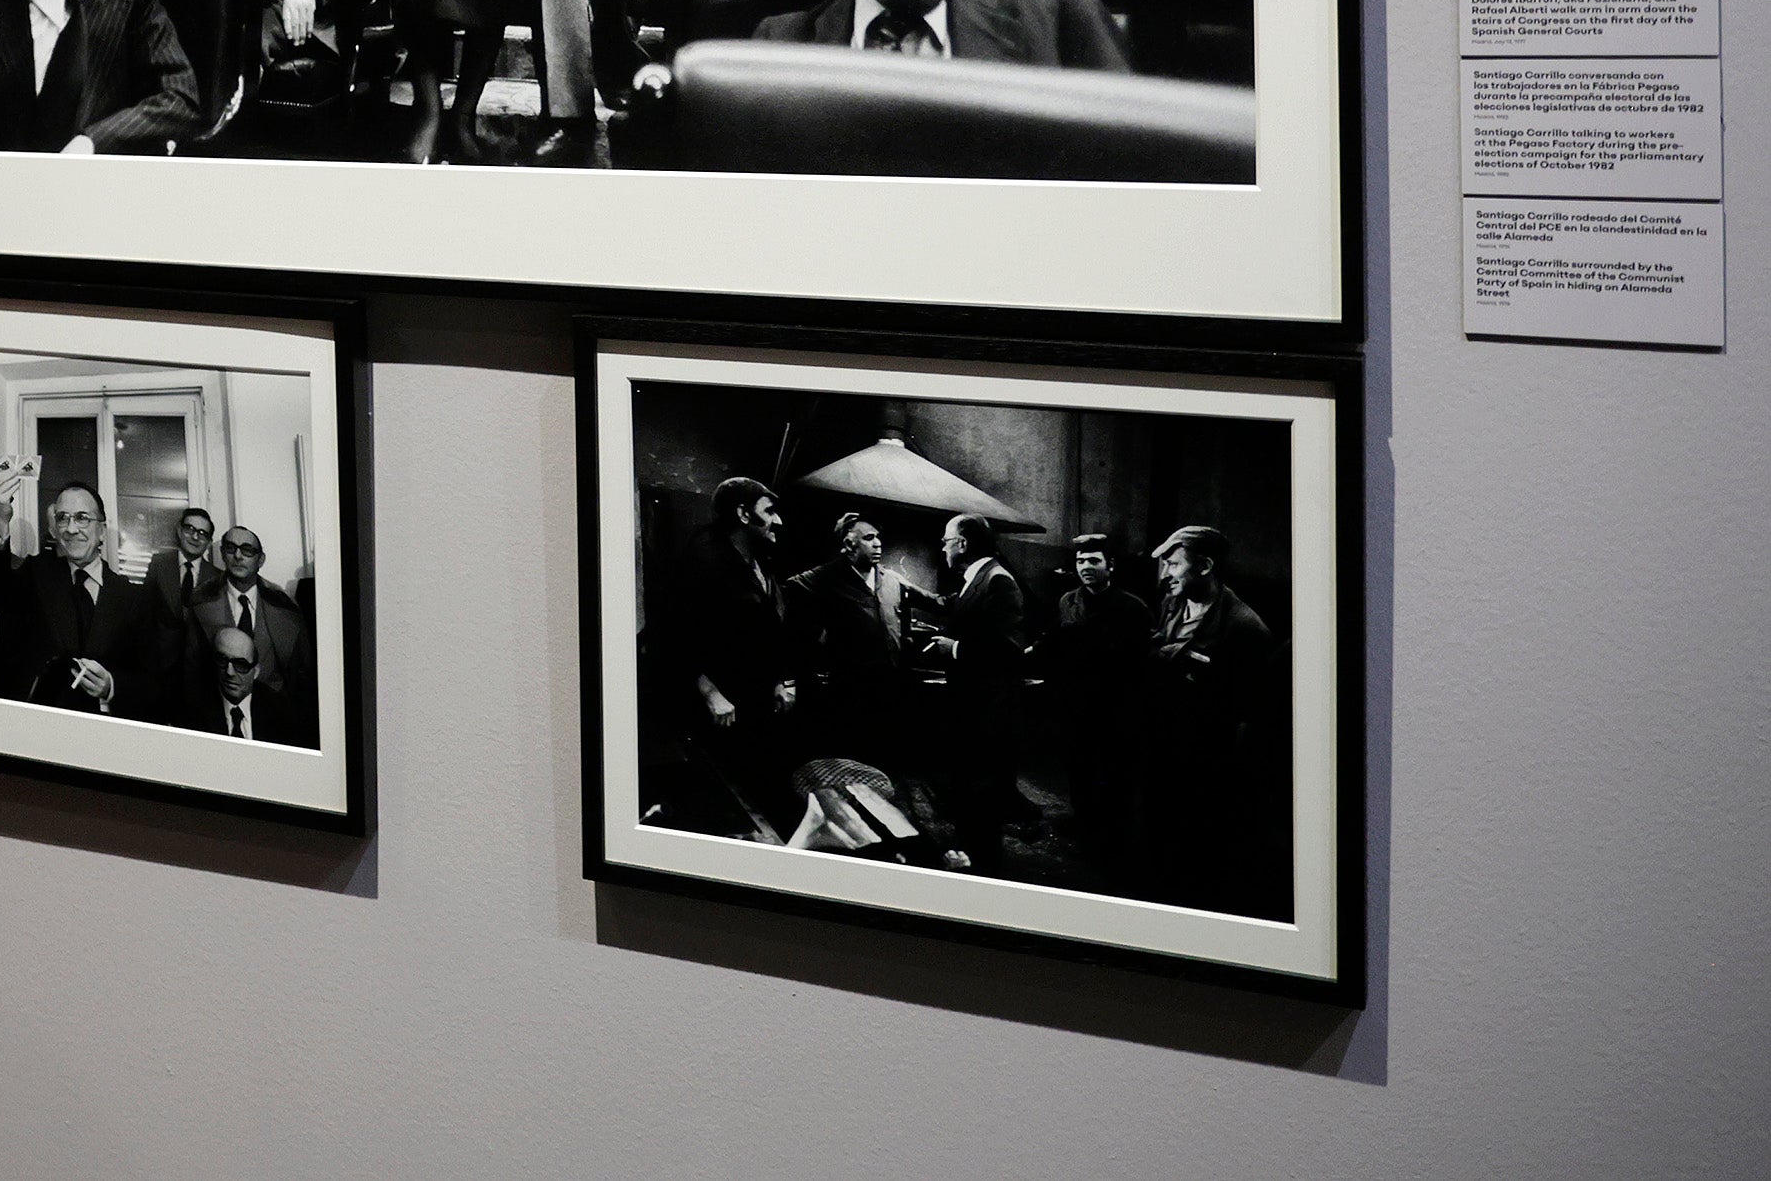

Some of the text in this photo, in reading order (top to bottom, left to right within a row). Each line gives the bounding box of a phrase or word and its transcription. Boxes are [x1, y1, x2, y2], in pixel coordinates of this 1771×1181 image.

[1472, 27, 1602, 37] Spanish General Courts
[1474, 71, 1522, 80] Santiago
[1525, 71, 1566, 79] Carrillo
[1475, 128, 1524, 138] Santiago
[1526, 129, 1568, 137] Carrillo
[1572, 129, 1611, 139] talking
[1629, 131, 1674, 139] workers
[1475, 160, 1524, 168] elections
[1540, 161, 1586, 169] October
[1477, 211, 1524, 221] Santiago
[1528, 212, 1568, 220] Carrillo
[1572, 214, 1617, 222] rodeado
[1640, 215, 1681, 223] Comité
[1504, 233, 1553, 241] Alameda
[1477, 257, 1672, 273] Santiago Carrillo surrounded by the
[1477, 267, 1684, 283] Central Committee of the Communist
[1477, 289, 1509, 297] Street
